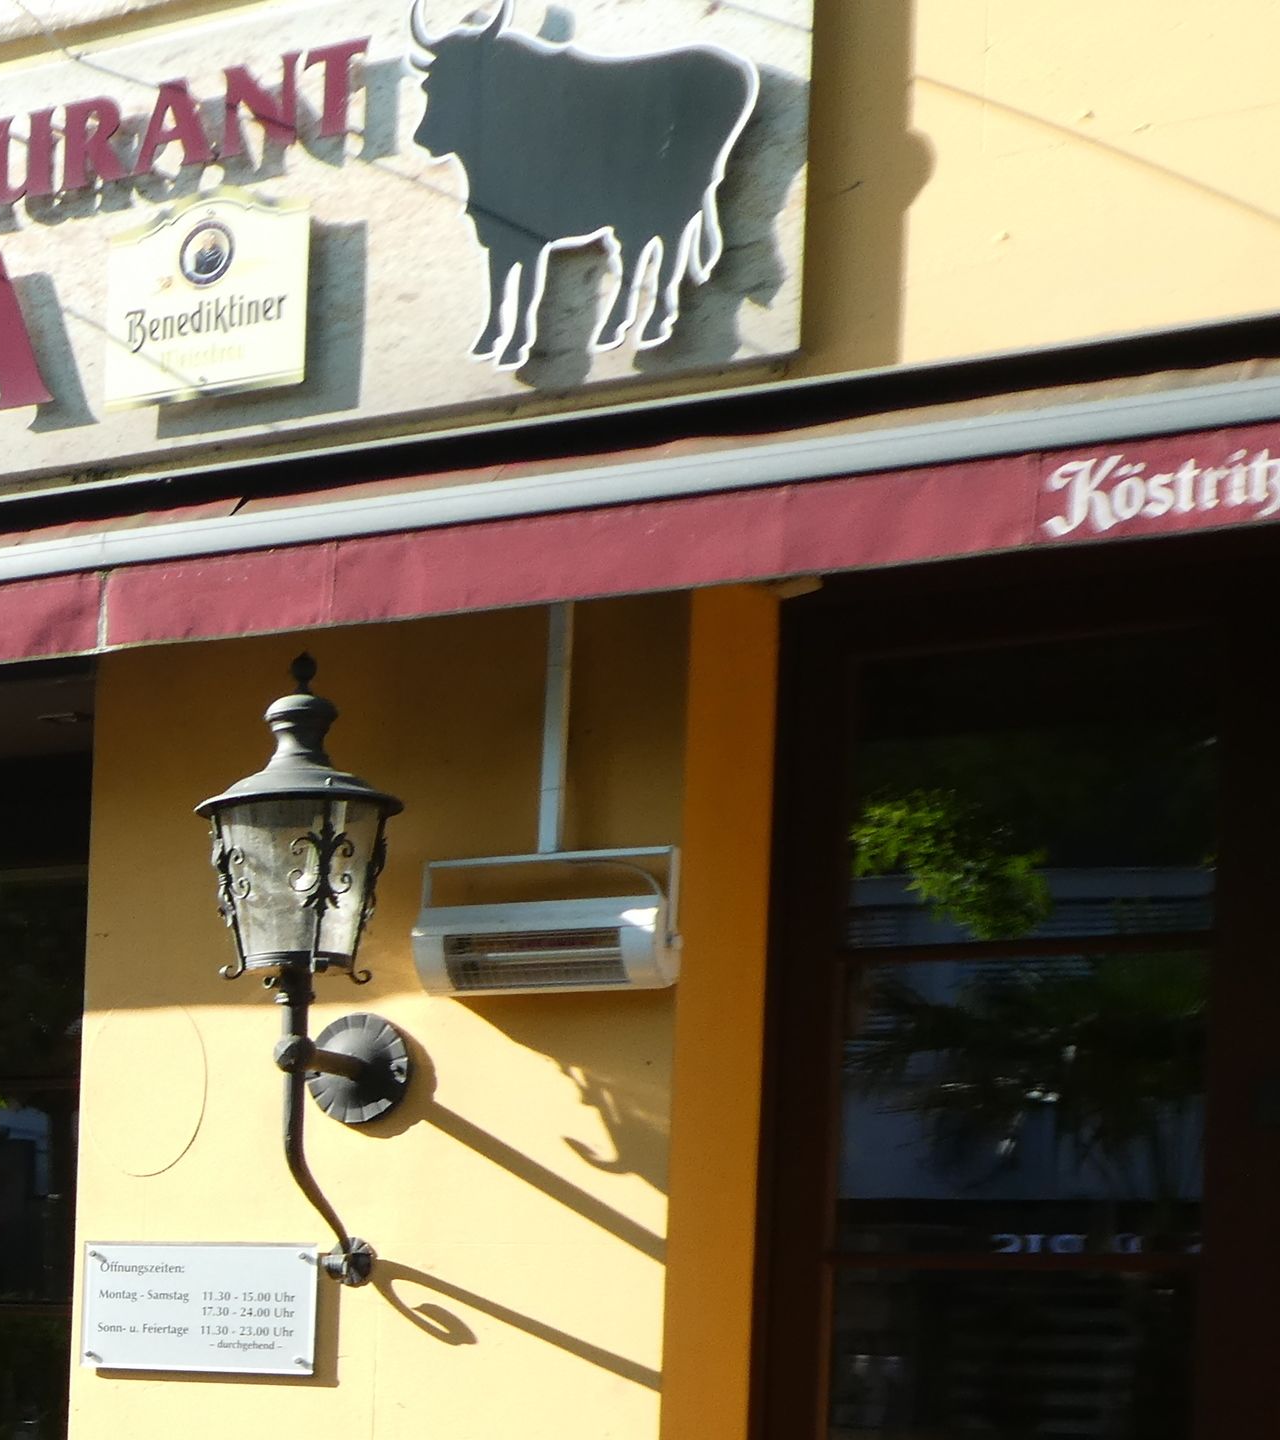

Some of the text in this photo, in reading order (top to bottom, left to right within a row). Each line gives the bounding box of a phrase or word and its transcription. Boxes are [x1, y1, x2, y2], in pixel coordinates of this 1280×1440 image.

[124, 294, 289, 355] Benediktiner
[99, 1289, 138, 1303] Montag
[147, 1289, 190, 1304] Samstag
[202, 1291, 231, 1301] 11.30
[242, 1291, 271, 1302] 15.00
[274, 1291, 296, 1303] Uhr
[201, 1306, 230, 1317] 17.30
[240, 1306, 271, 1318] 24.00
[273, 1307, 295, 1318] Uhr
[97, 1321, 127, 1333] Sonn-
[142, 1322, 190, 1338] Feiertage
[200, 1325, 229, 1336] 11.30
[239, 1326, 270, 1337] 23.00
[273, 1326, 294, 1337] Uhr
[216, 1339, 276, 1352] durchgehend
